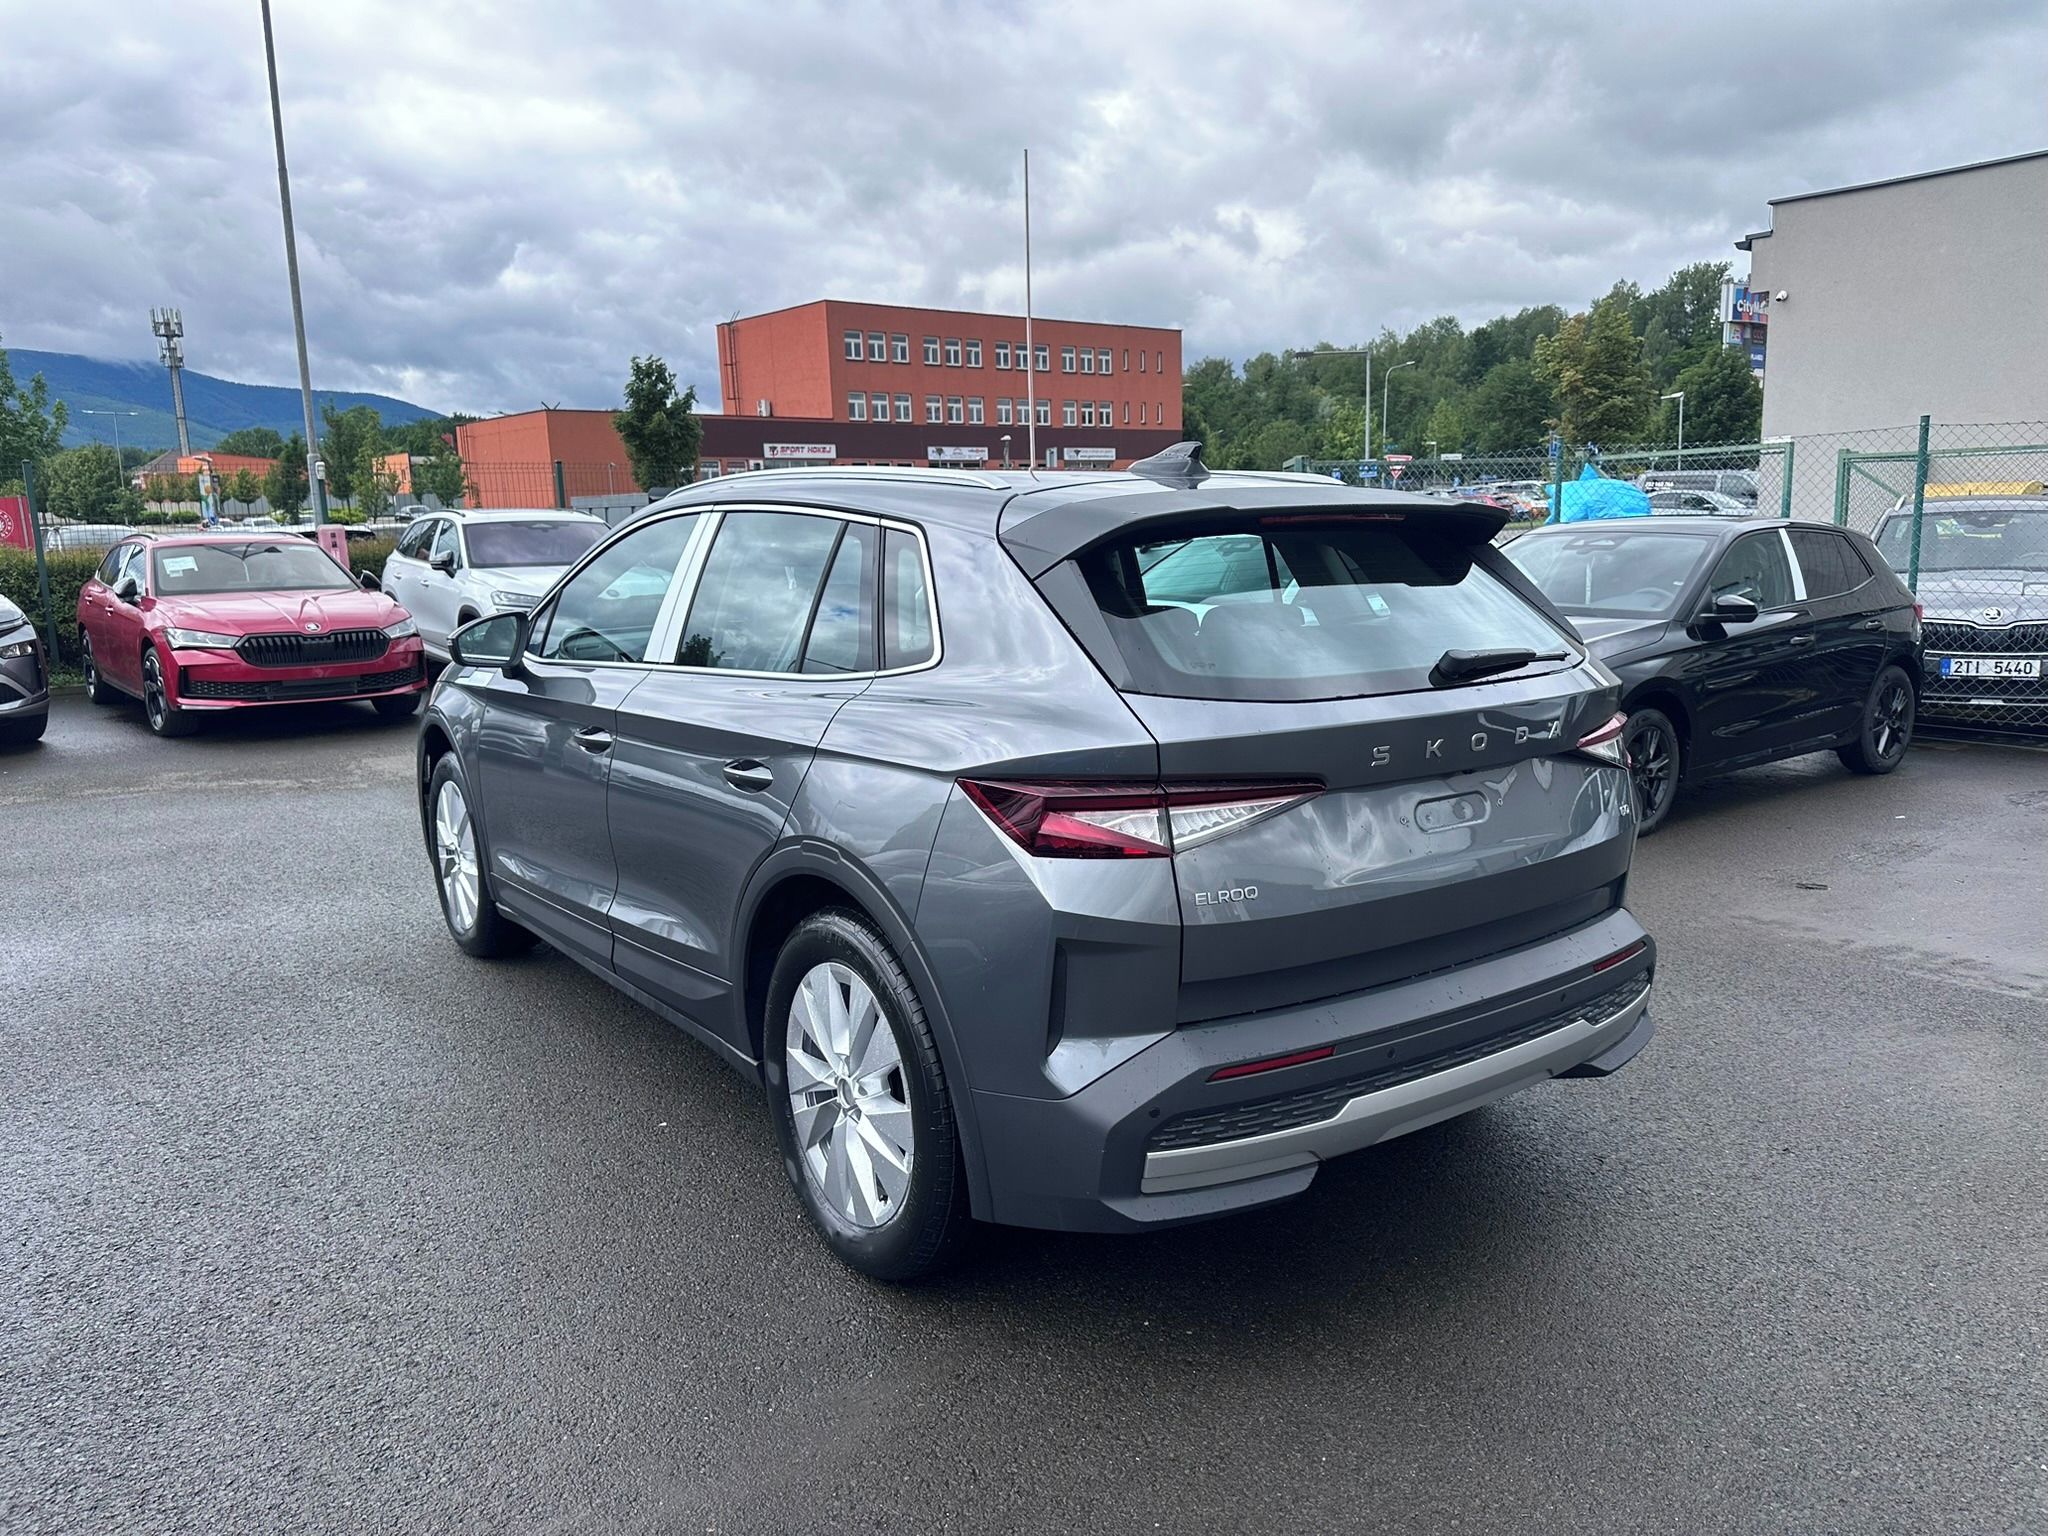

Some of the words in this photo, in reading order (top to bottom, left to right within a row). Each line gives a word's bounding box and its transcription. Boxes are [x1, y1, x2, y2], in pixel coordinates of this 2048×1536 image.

[1954, 660, 1980, 674] 2TI
[1994, 661, 2033, 675] 5440
[1370, 720, 1563, 767] SKODA
[1195, 886, 1259, 906] ELROQ
